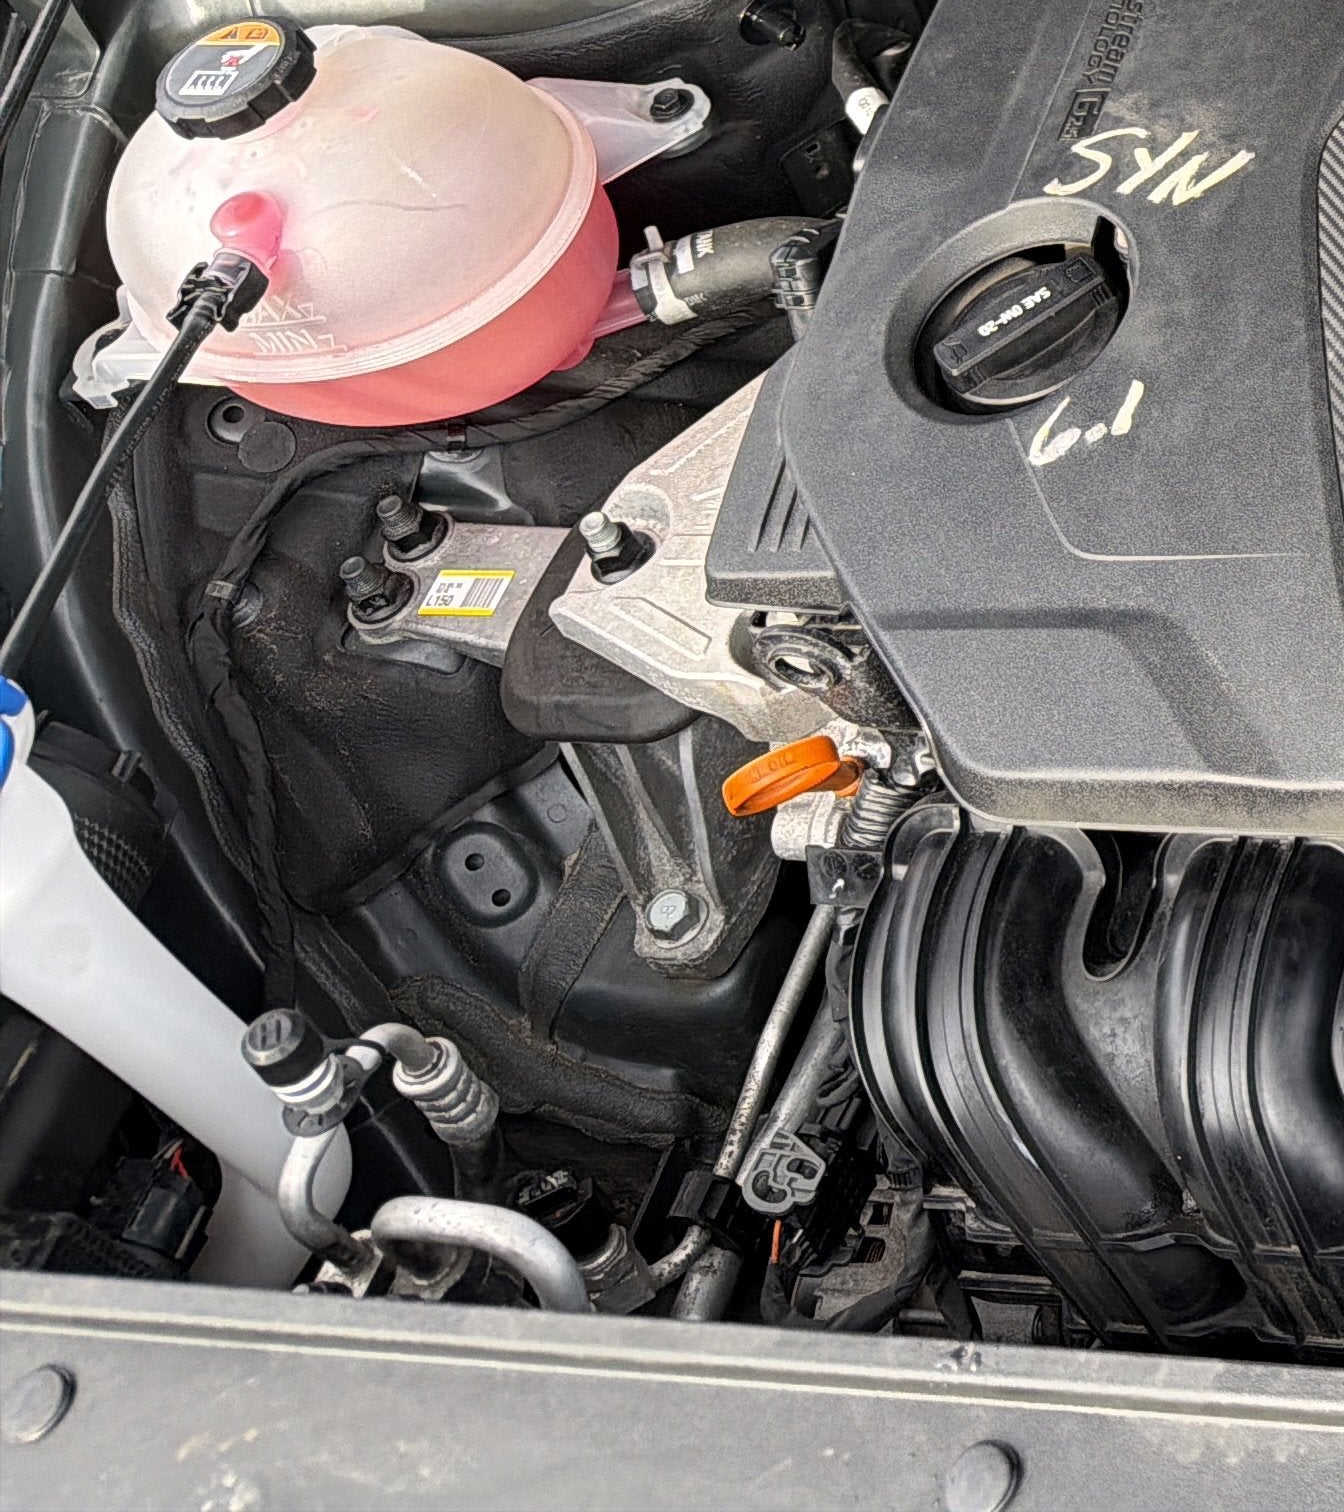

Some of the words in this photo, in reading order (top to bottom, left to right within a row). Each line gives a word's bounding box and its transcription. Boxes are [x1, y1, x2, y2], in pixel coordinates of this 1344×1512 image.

[1044, 127, 1256, 207] SYN
[1011, 285, 1052, 312] SAE
[977, 299, 1024, 337] 0W-20
[249, 329, 319, 354] MIN
